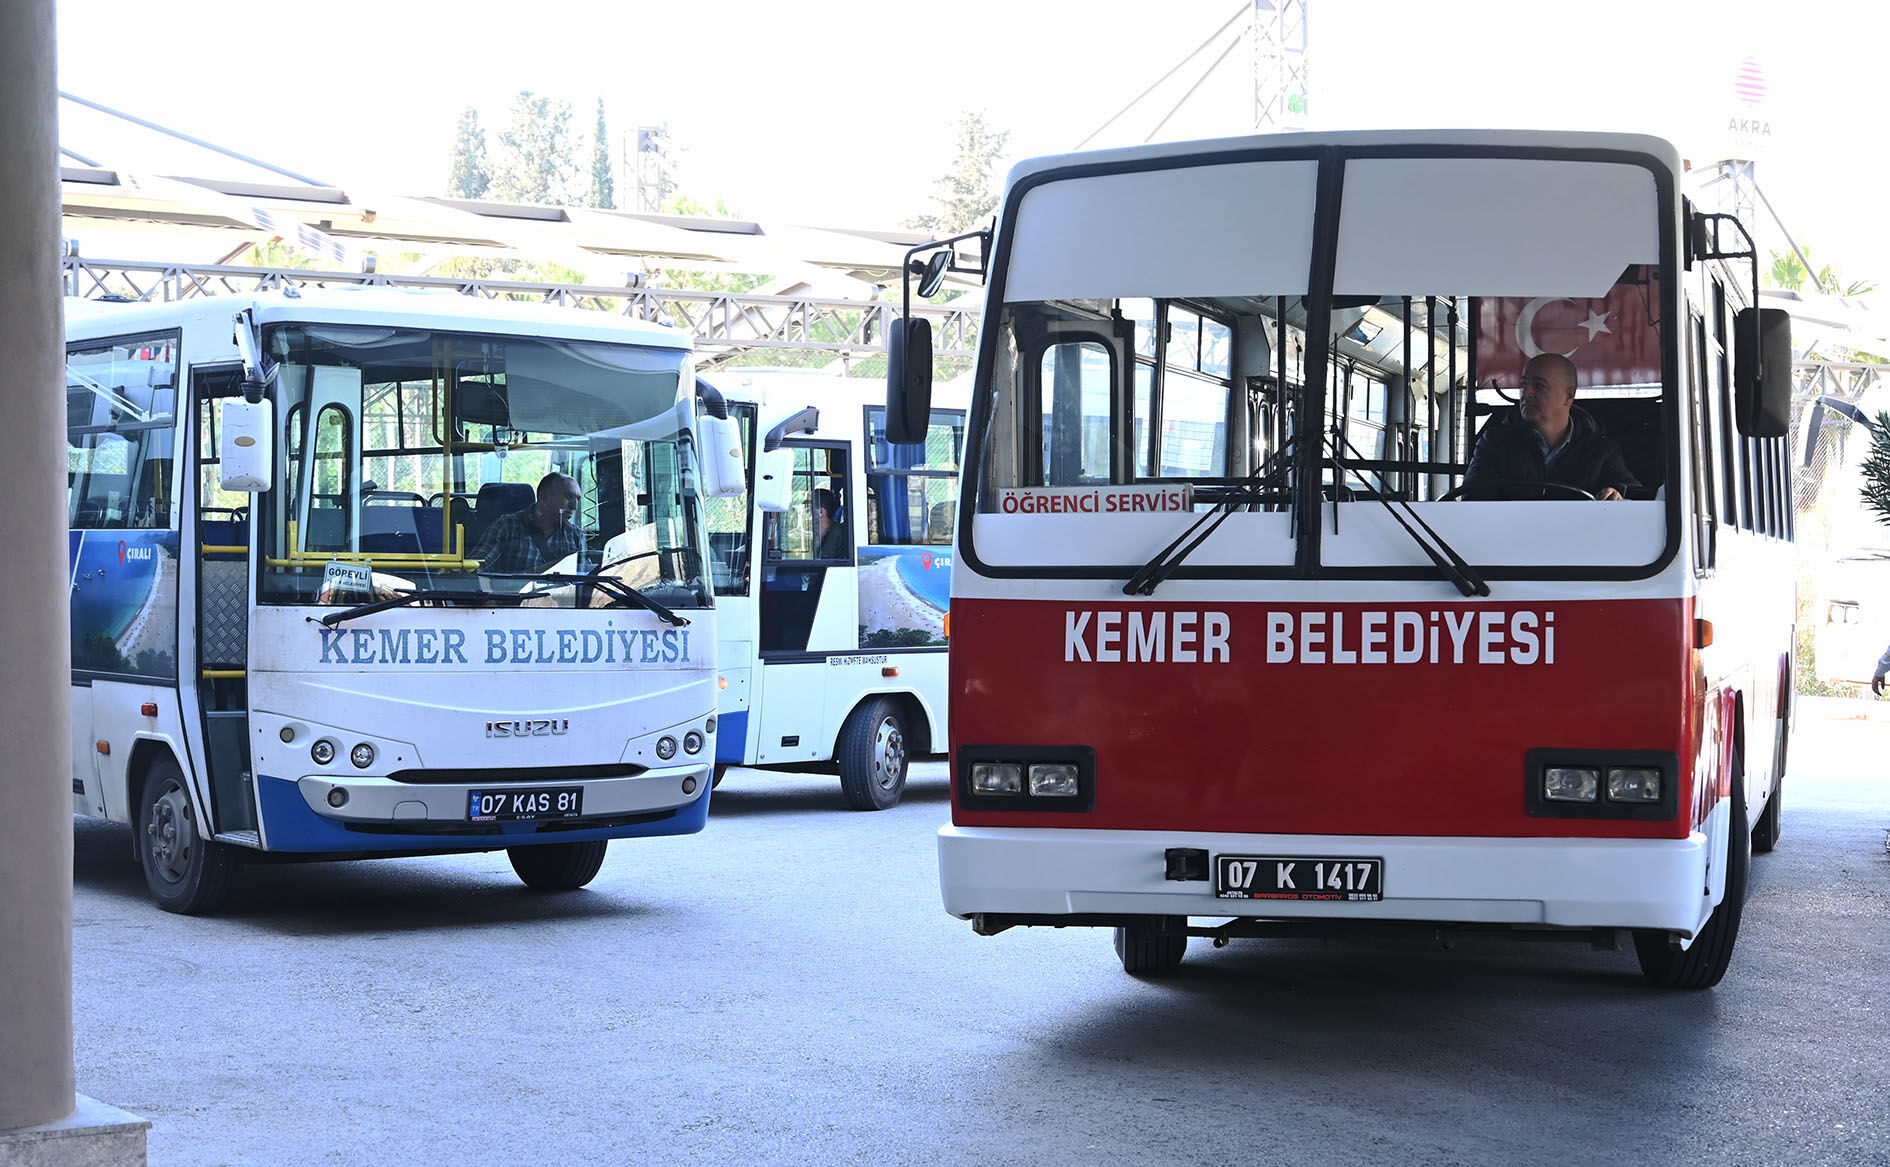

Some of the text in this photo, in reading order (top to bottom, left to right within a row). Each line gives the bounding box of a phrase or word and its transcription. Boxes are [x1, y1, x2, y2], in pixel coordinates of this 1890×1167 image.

[1728, 117, 1772, 137] AKRA
[1002, 488, 1188, 514] ÖĞRENCİ SERVİSİ
[126, 547, 151, 561] ÇIRALI
[328, 566, 369, 581] GÖREVLİ
[319, 620, 691, 665] KEMER BELEDİYESİ
[1065, 610, 1231, 663] KEMER
[486, 718, 569, 739] ISUZU
[481, 792, 577, 814] 07 KAS 81
[1228, 861, 1372, 890] 07 K 1417
